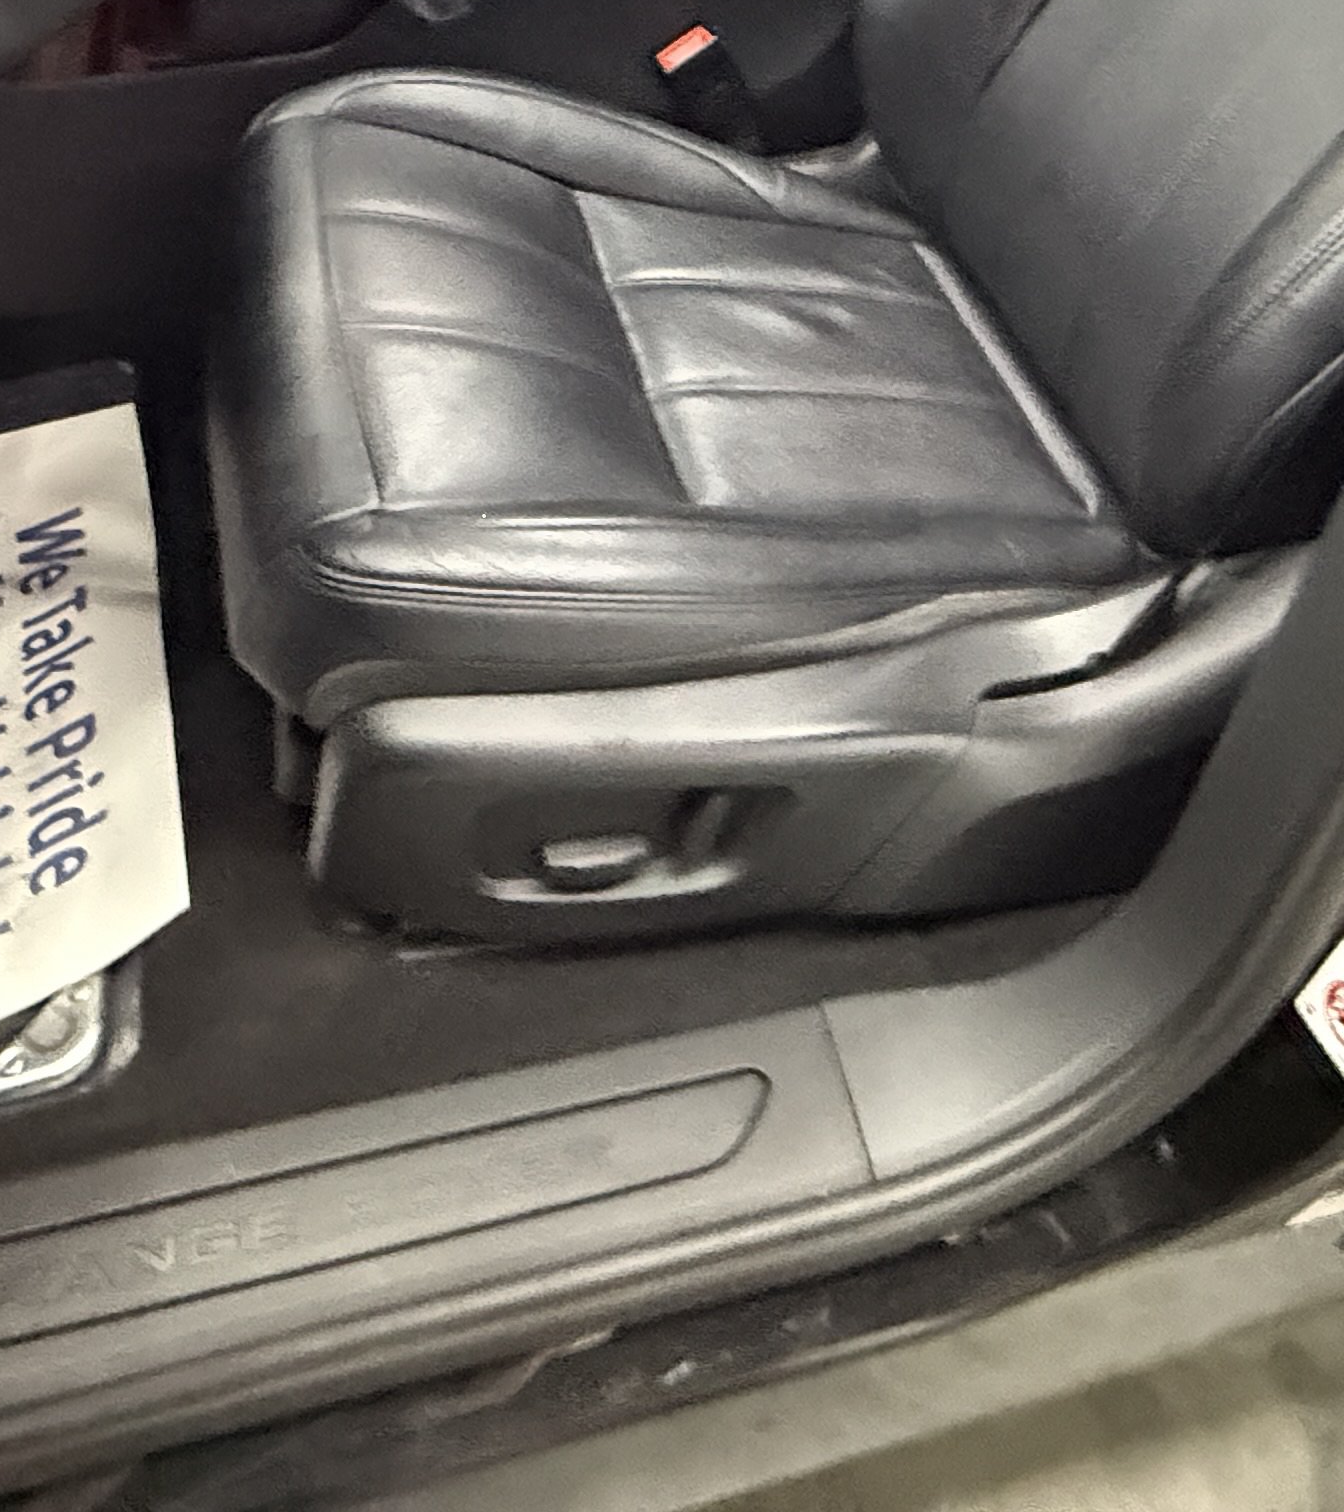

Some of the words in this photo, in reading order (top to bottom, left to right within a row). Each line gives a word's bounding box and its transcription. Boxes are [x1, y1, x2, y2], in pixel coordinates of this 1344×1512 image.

[16, 507, 86, 595] We
[22, 585, 94, 721] Take
[25, 713, 108, 896] Pride
